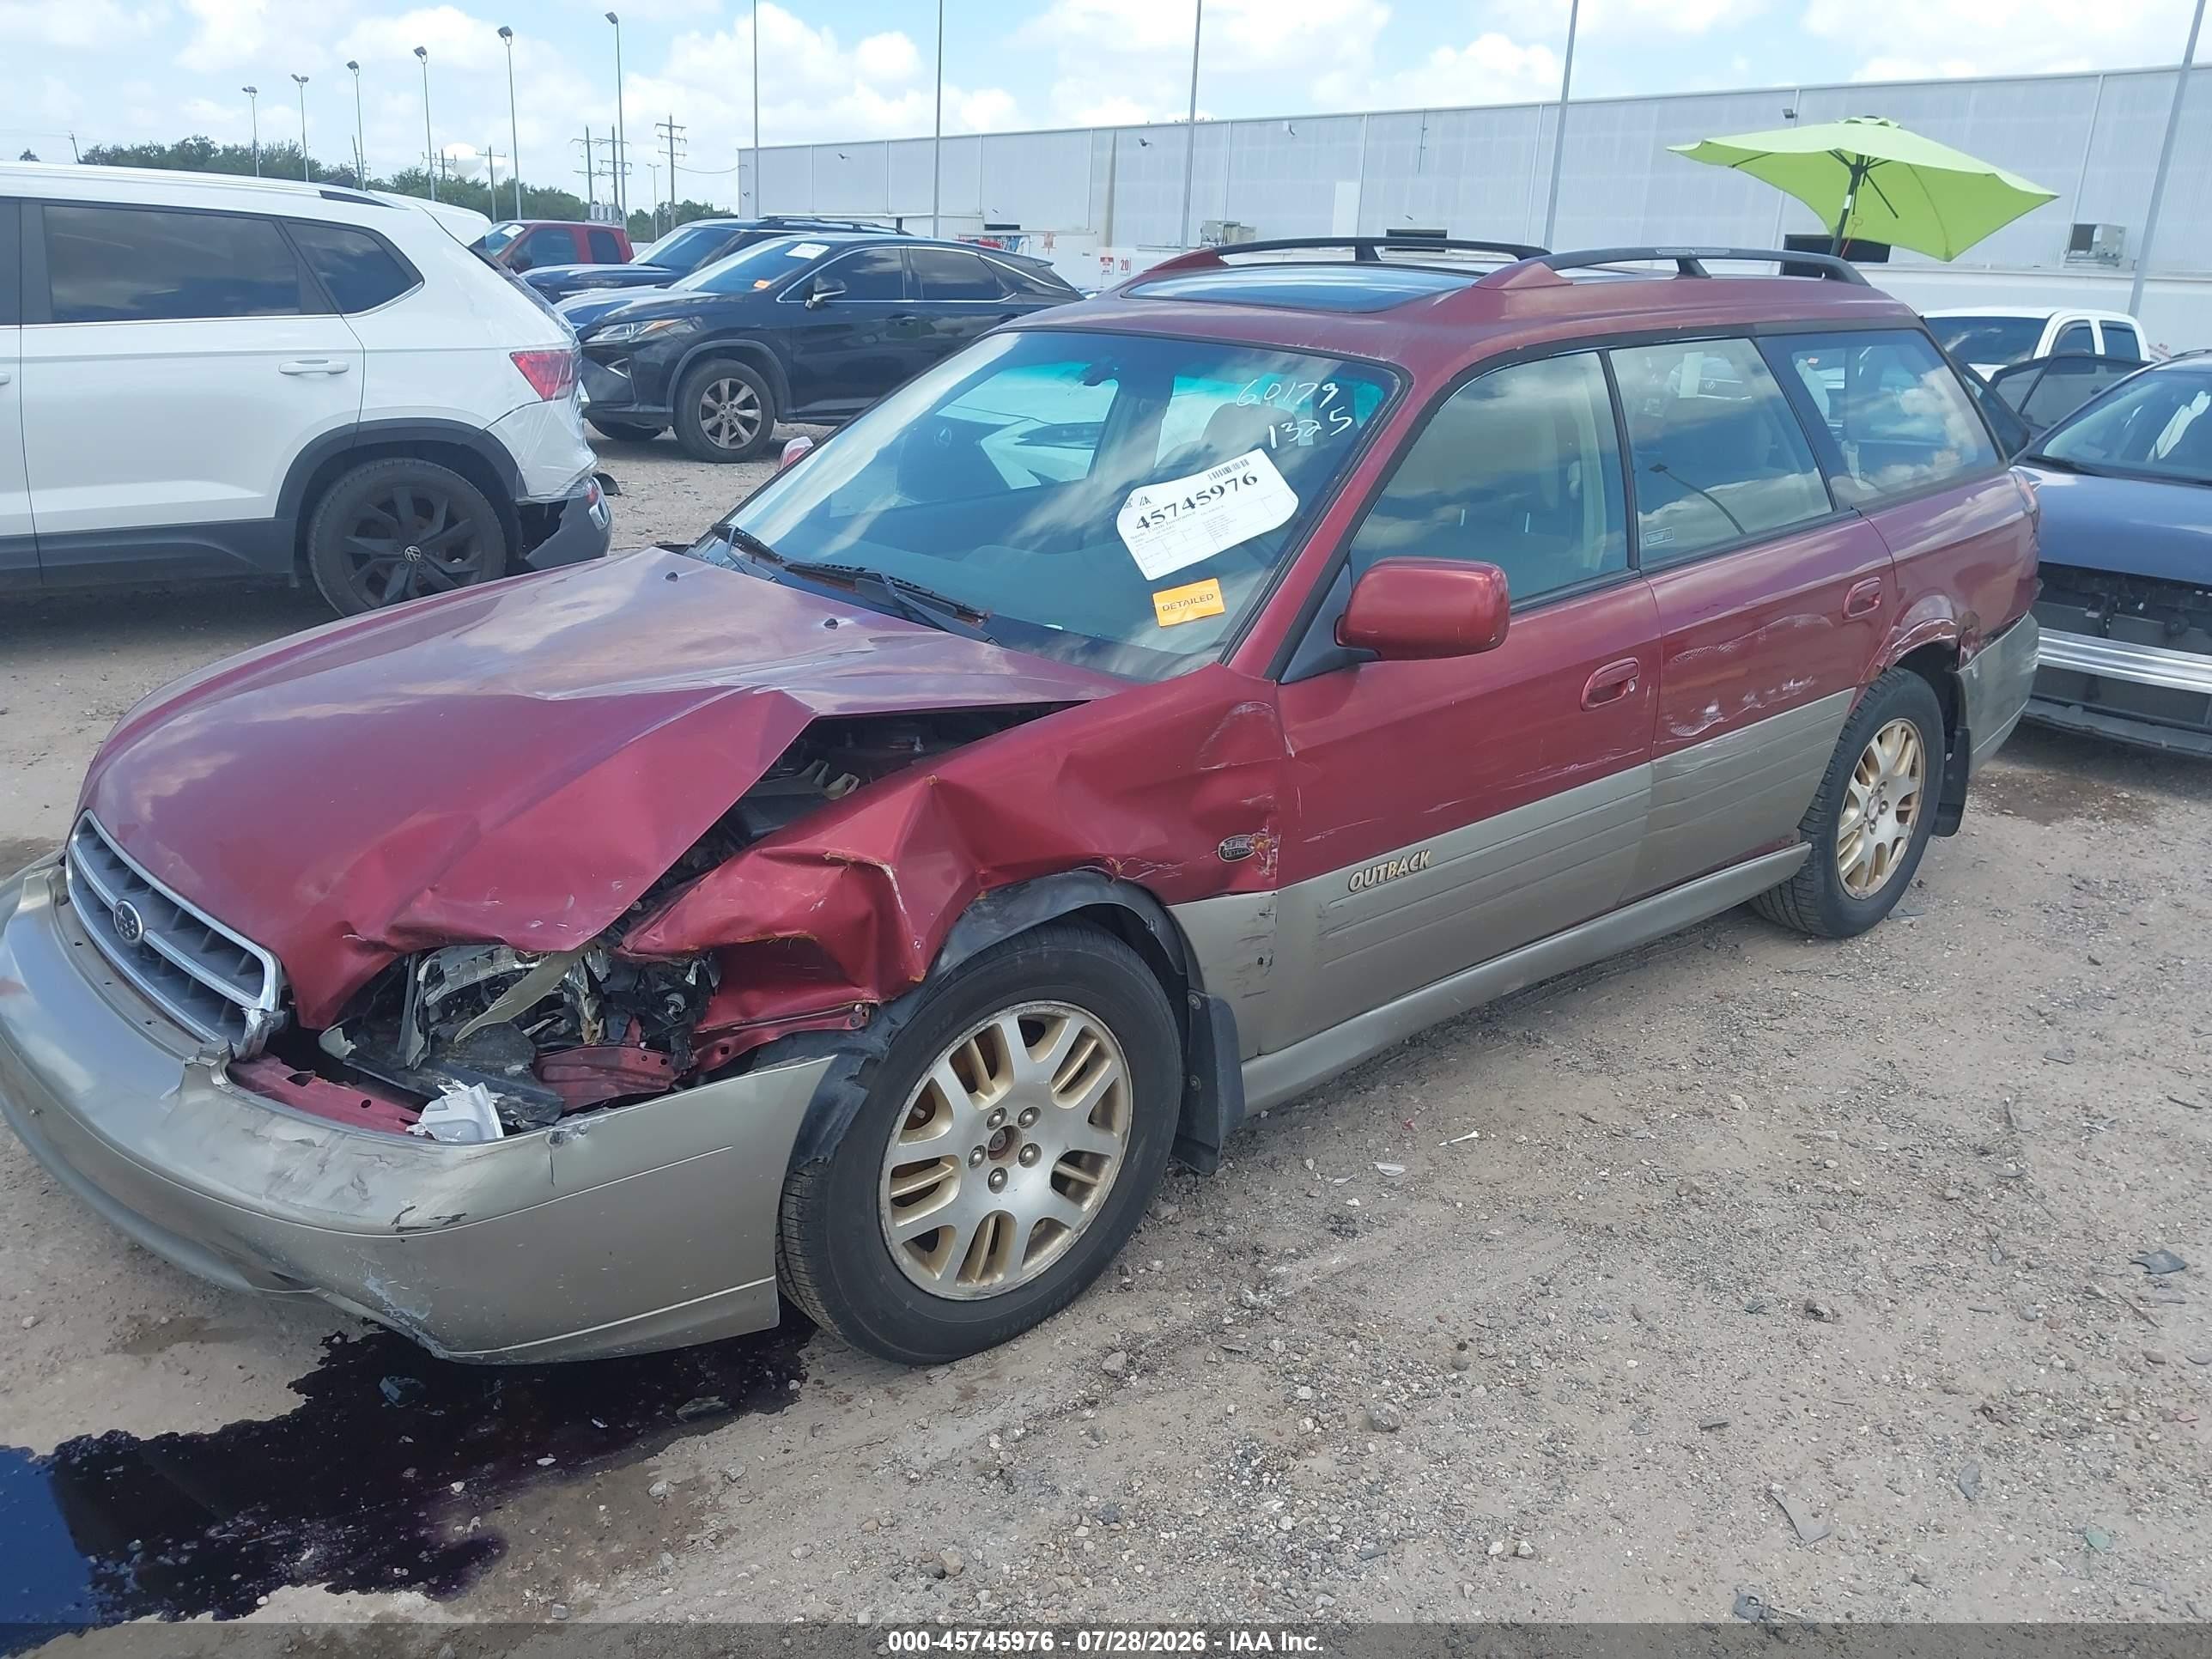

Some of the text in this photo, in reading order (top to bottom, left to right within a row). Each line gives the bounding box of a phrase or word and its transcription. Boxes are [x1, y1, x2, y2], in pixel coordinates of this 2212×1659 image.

[1120, 259, 1129, 271] 20
[1236, 379, 1340, 409] 60179
[1268, 406, 1353, 449] 1325
[1136, 471, 1258, 530] 45745976
[1162, 593, 1214, 611] DETAILED
[1347, 849, 1431, 893] OUTBACK
